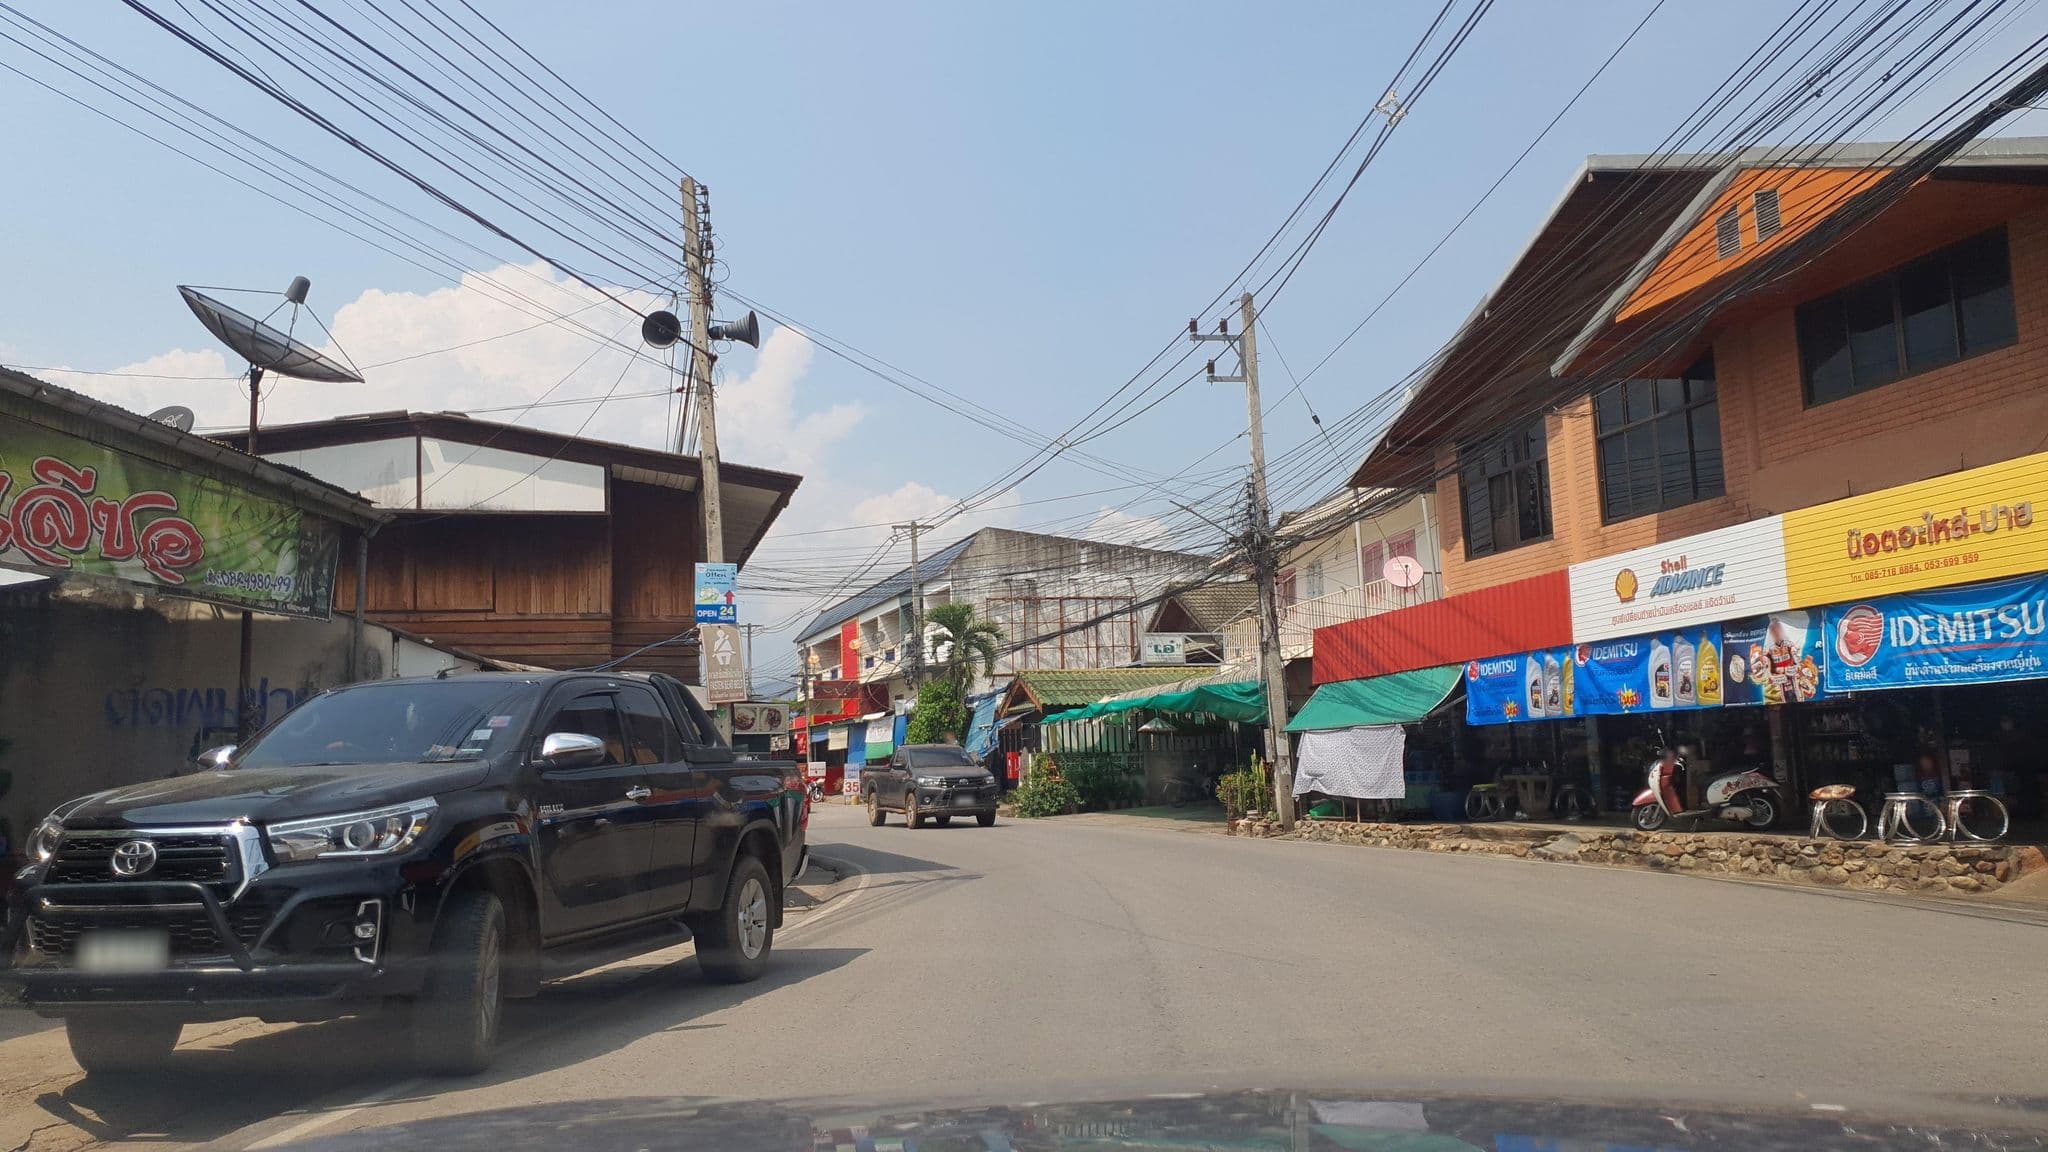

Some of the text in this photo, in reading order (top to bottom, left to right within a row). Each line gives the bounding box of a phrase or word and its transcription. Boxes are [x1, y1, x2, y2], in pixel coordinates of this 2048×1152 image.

[1660, 555, 1687, 574] Shell
[1963, 553, 1979, 564] 959
[1650, 563, 1725, 598] ADVANCE
[697, 605, 734, 618] OPEN 24
[1890, 600, 2046, 648] IDEMITSU
[1593, 643, 1638, 660] IDEMITSU
[1480, 659, 1517, 675] IDEMITSU
[845, 781, 859, 793] 35
